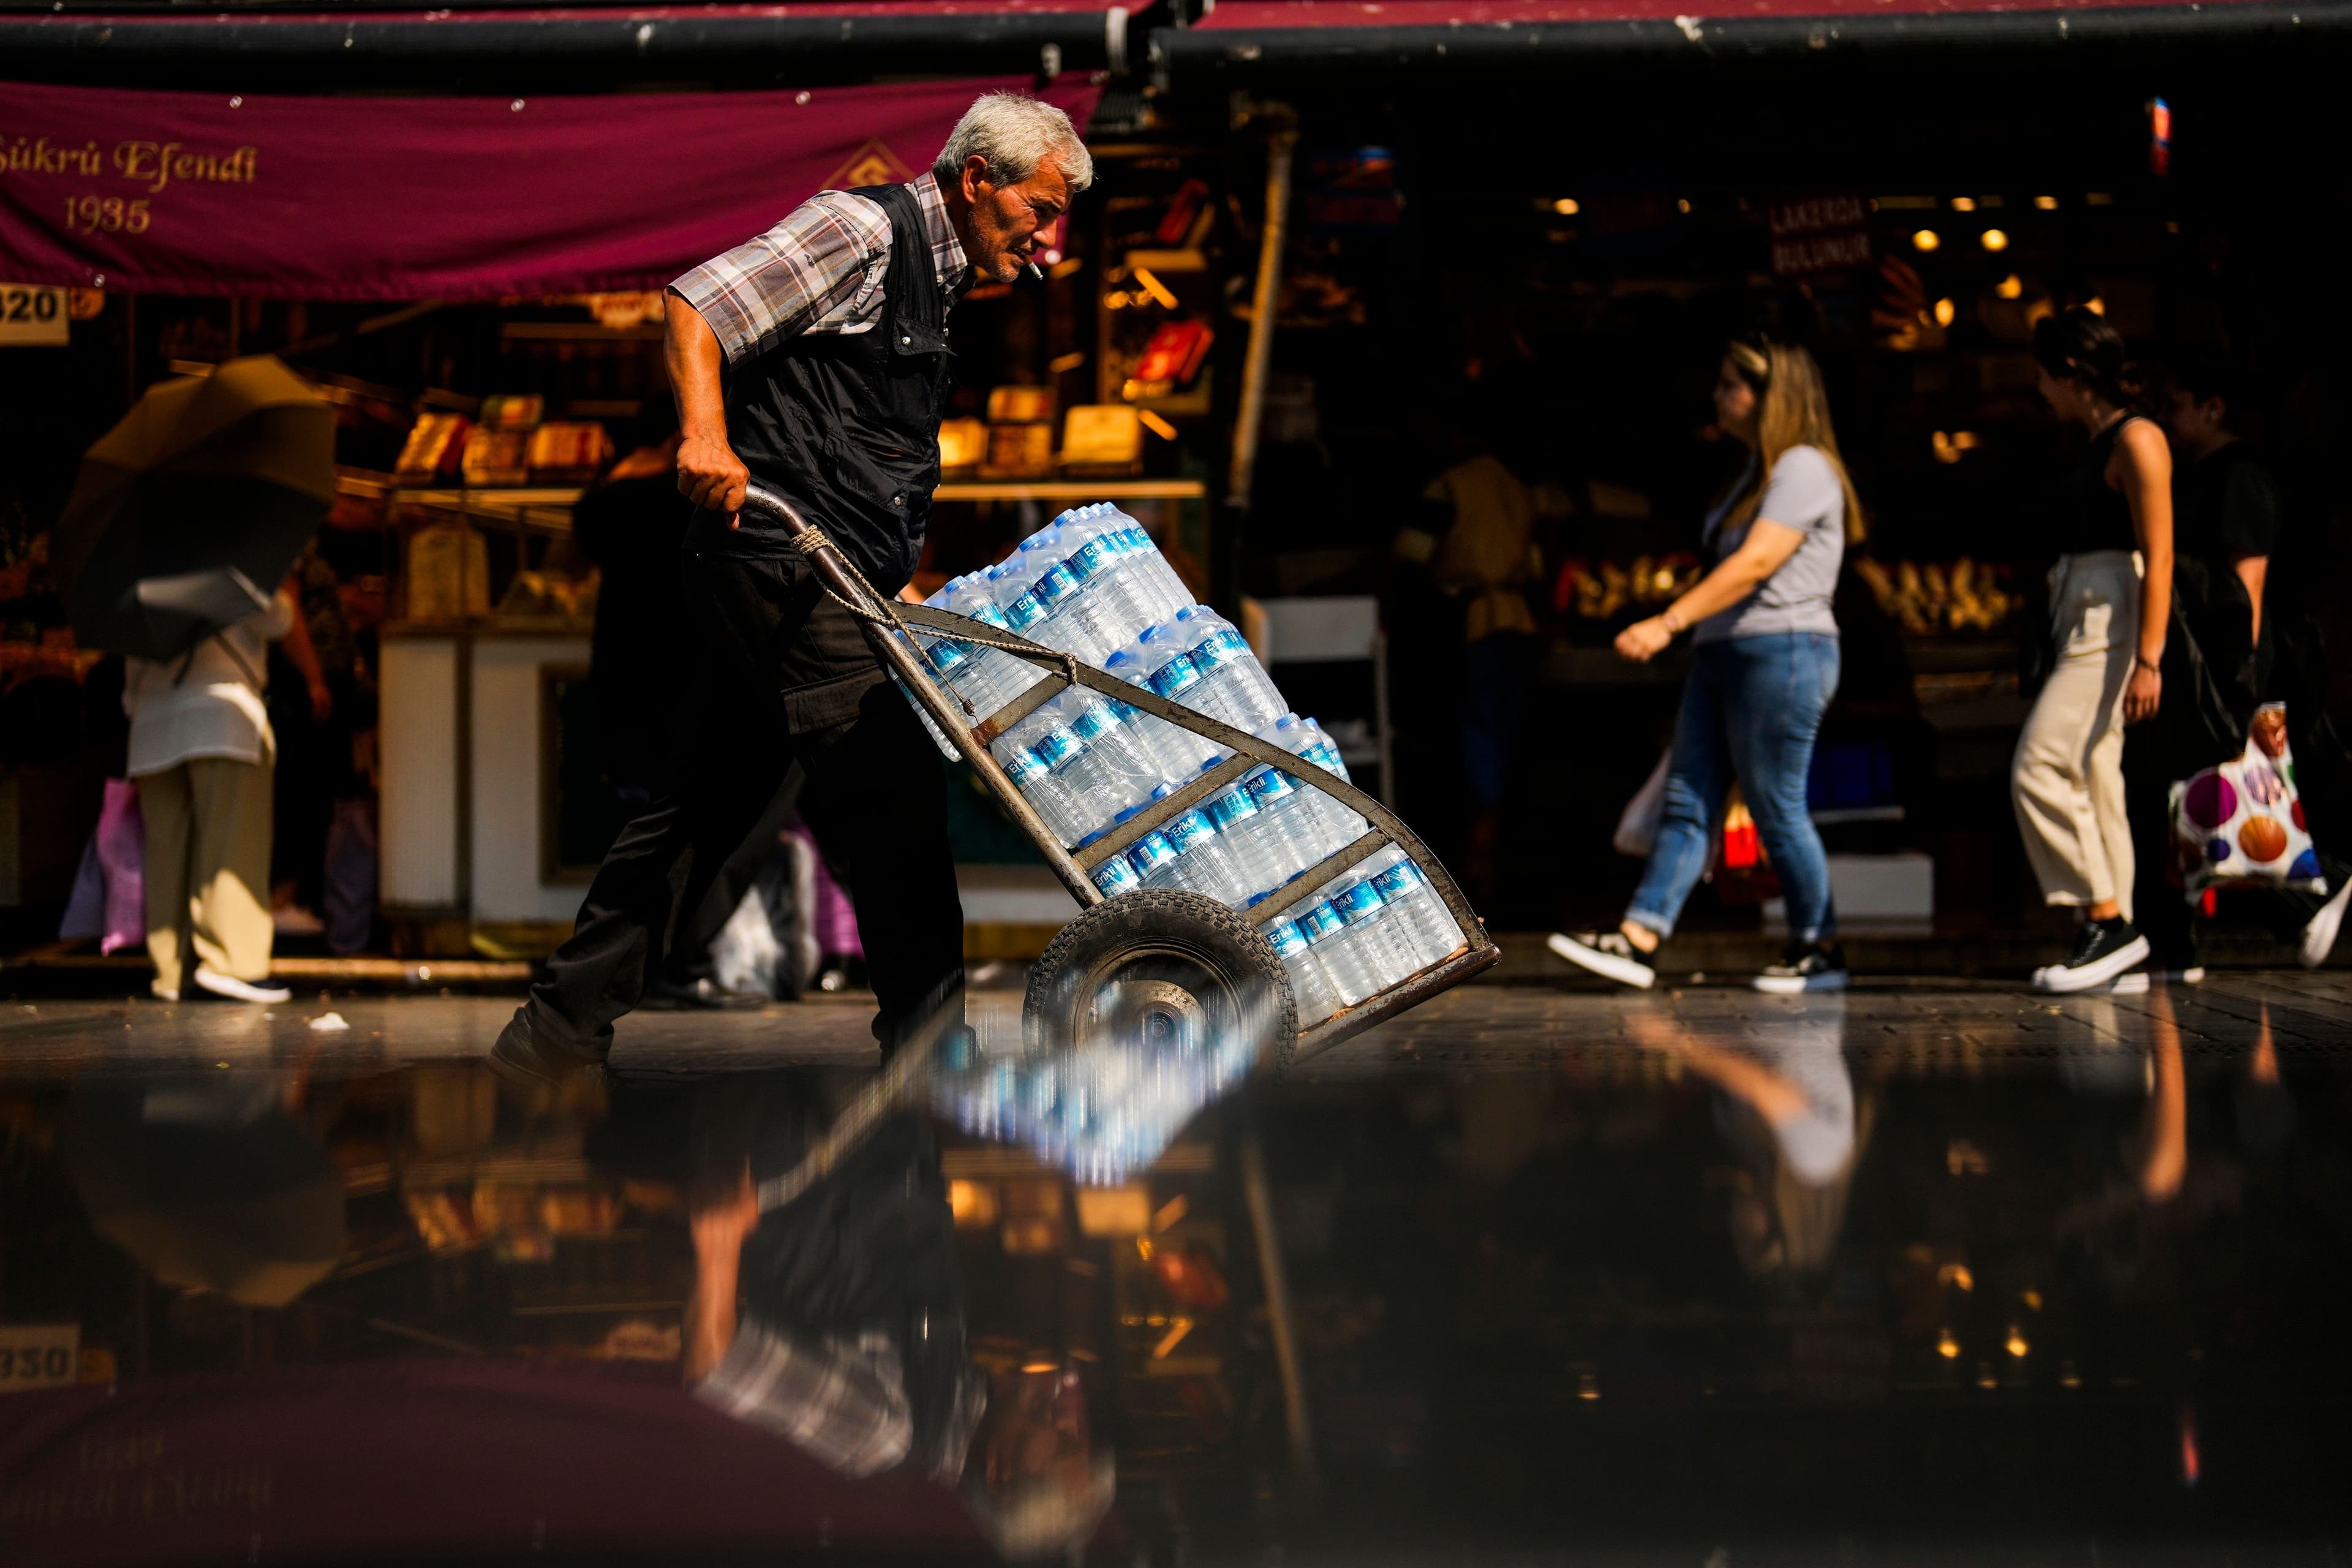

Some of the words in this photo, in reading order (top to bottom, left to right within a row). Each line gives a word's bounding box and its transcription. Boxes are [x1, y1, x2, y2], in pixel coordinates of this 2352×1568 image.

[64, 195, 151, 235] 1935
[0, 288, 57, 323] 20
[1269, 925, 1294, 944] Erikli
